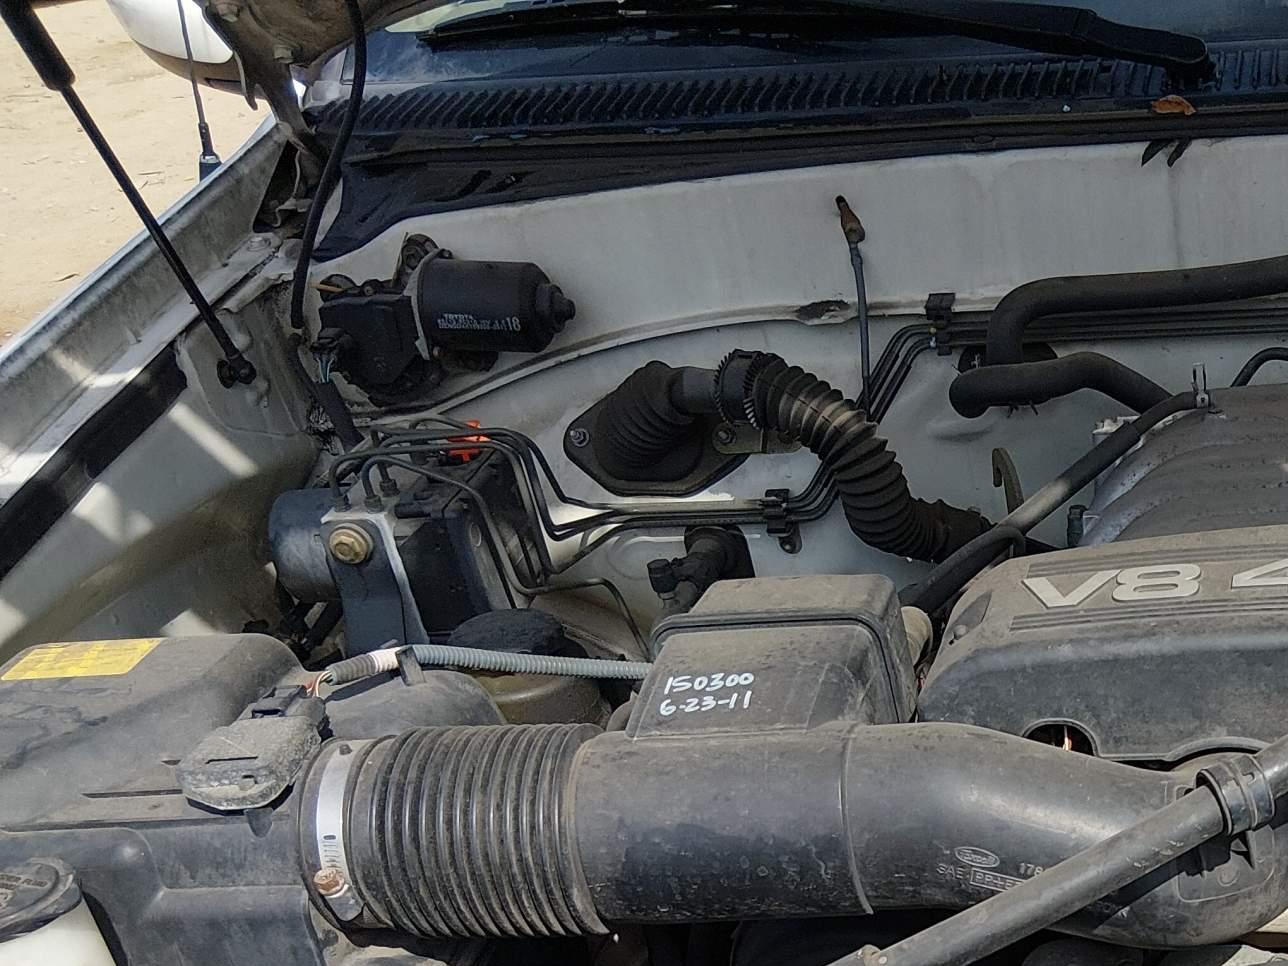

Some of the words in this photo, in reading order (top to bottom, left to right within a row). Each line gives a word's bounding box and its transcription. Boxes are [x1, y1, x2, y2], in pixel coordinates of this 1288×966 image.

[1021, 562, 1201, 608] V8
[663, 672, 755, 695] 150300
[659, 690, 753, 716] 6-23-11
